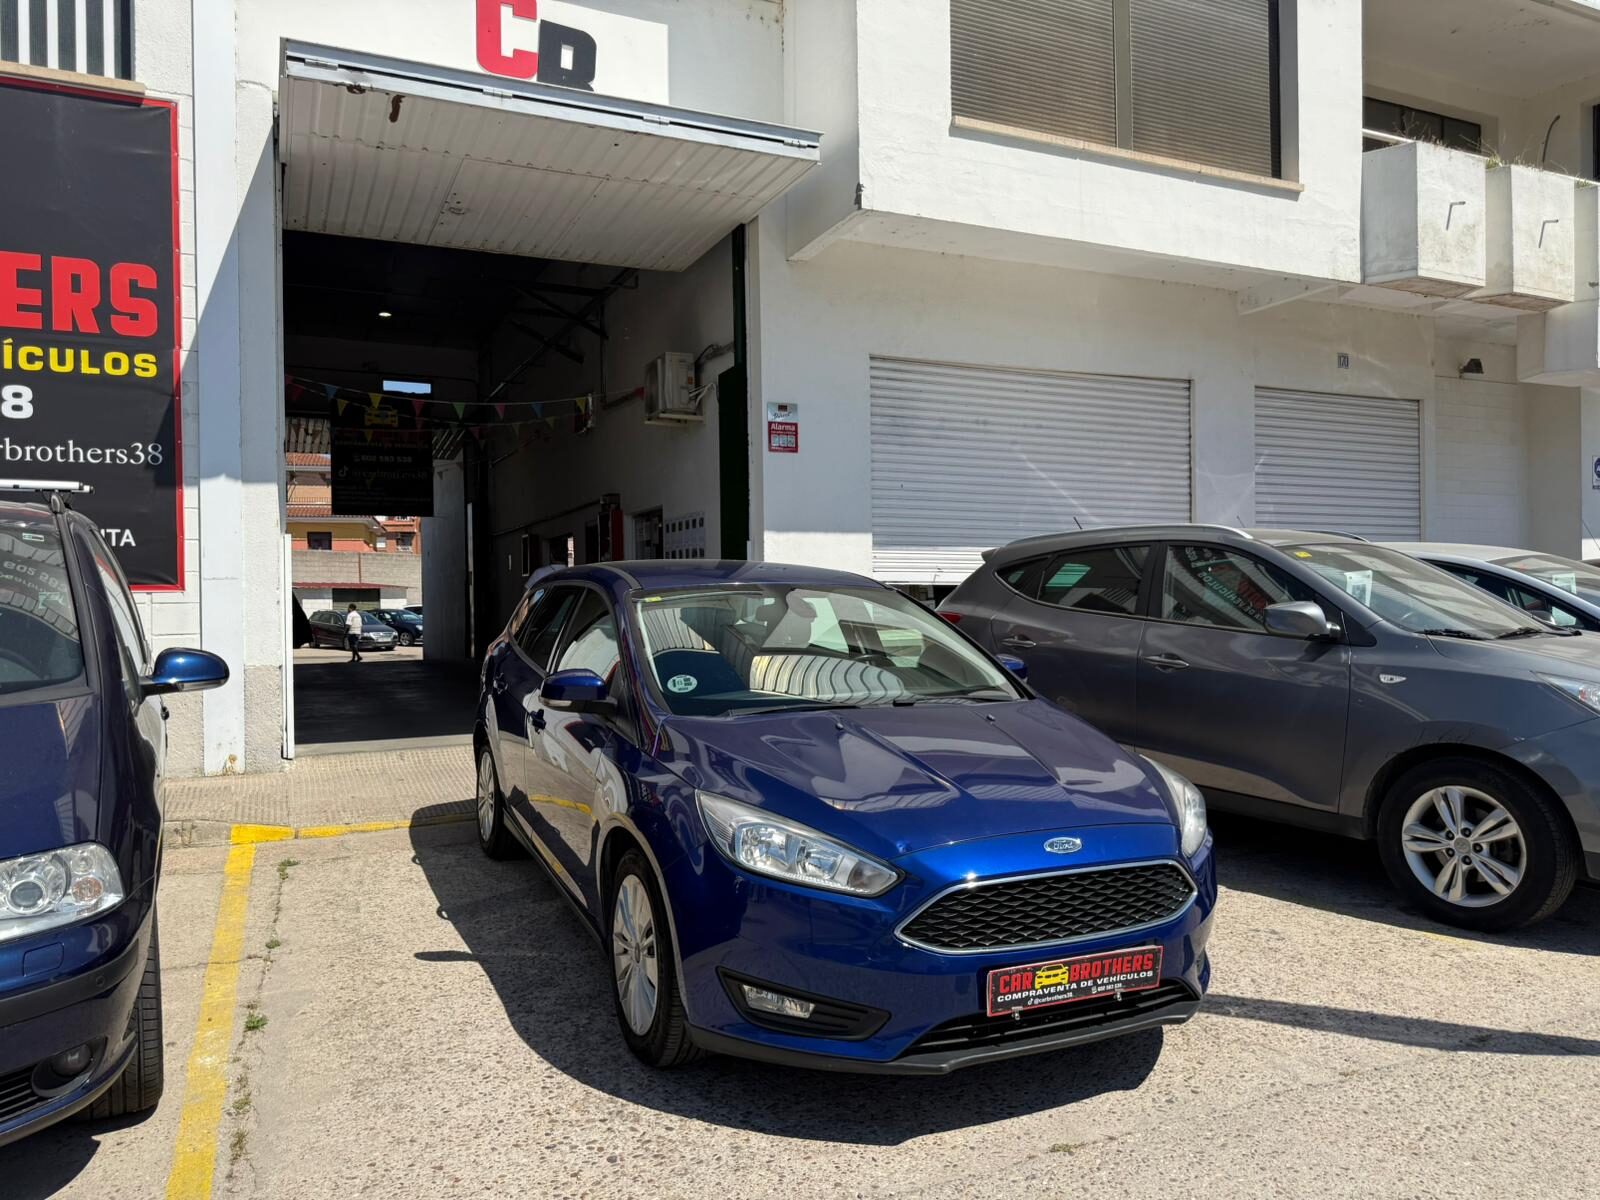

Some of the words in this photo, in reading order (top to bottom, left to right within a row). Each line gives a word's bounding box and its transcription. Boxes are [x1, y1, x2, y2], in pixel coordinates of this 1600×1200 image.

[0, 251, 158, 337] ERS
[3, 338, 158, 378] ÍCULOS
[1, 384, 33, 419] 8
[771, 423, 796, 431] Alarma
[101, 528, 136, 547] TA
[997, 983, 1078, 1002] COMPRAVENTA
[1080, 979, 1094, 988] DE
[1000, 972, 1033, 993] CAR
[1070, 953, 1153, 981] BROTHERS
